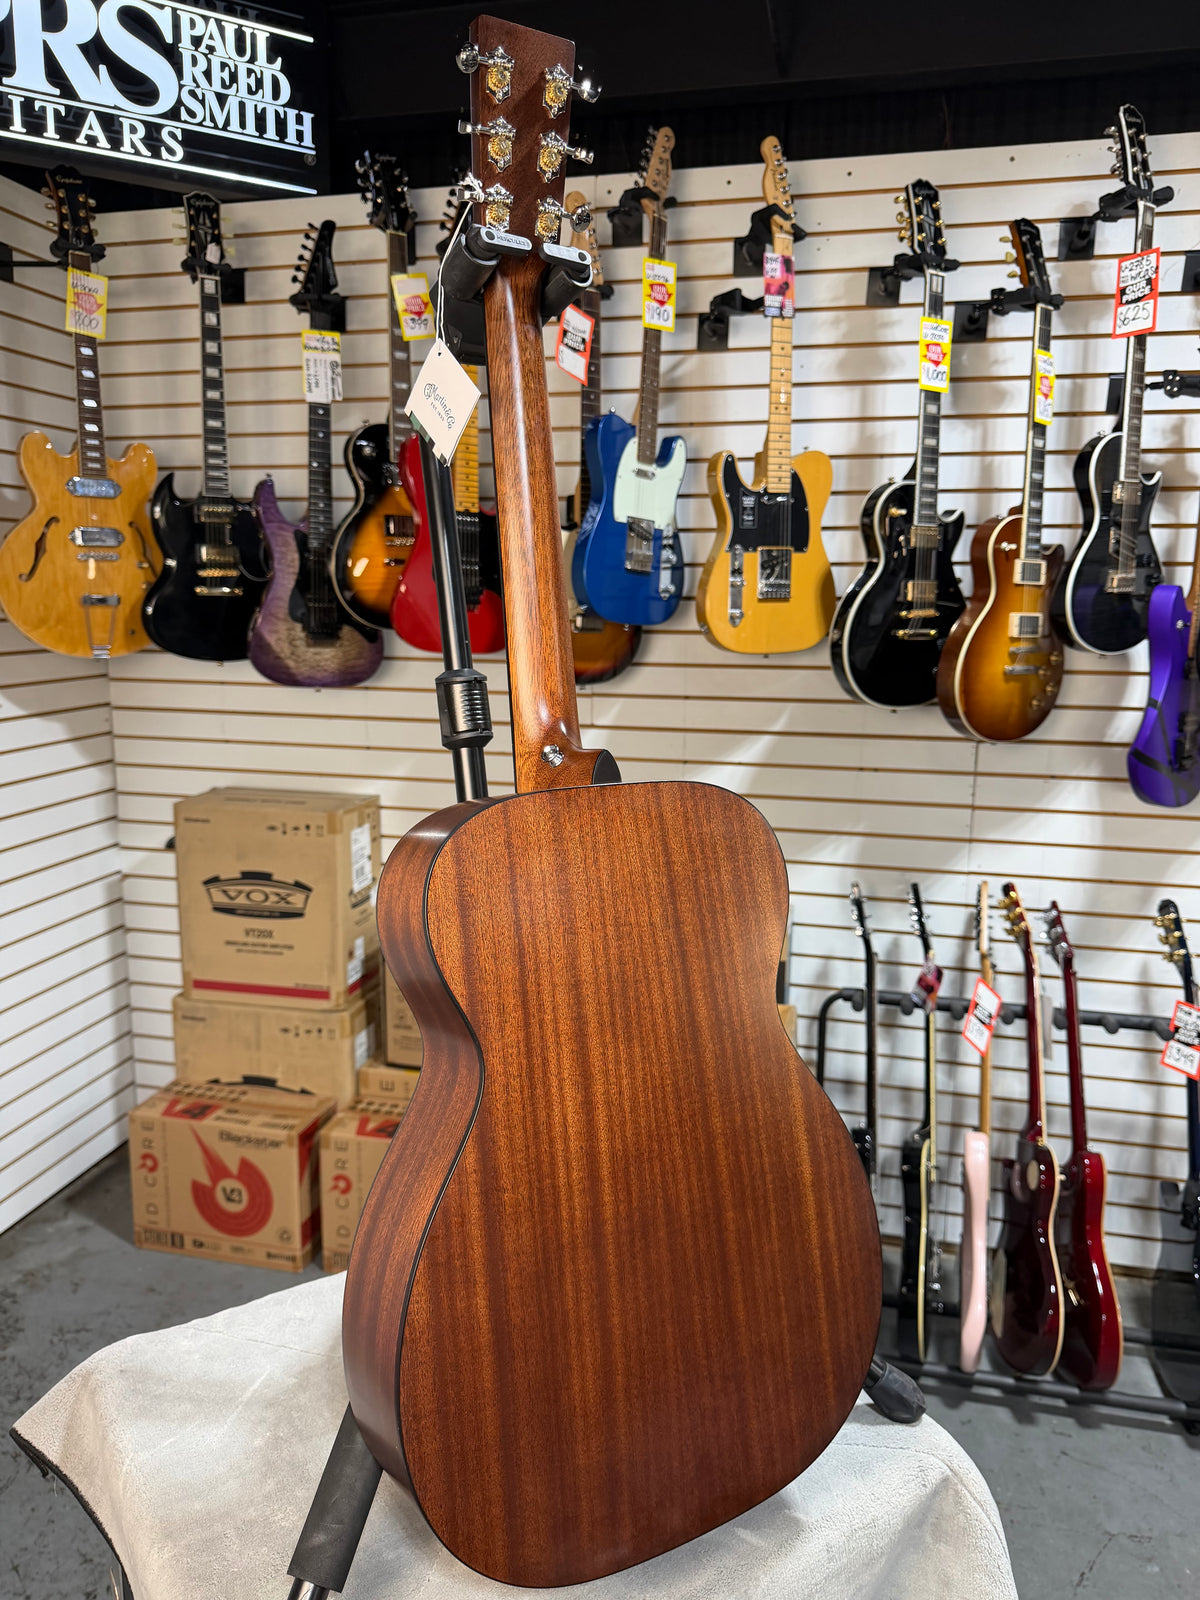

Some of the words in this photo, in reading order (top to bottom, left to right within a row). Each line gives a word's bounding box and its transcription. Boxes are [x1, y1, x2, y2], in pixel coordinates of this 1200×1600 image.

[0, 0, 179, 115] RS
[176, 10, 282, 70] PAUL
[178, 48, 291, 106] REED
[180, 87, 316, 149] SMITH
[1121, 285, 1152, 304] PRICE
[1125, 281, 1147, 294] OUR
[1117, 302, 1150, 329] $625
[216, 888, 297, 906] VOX
